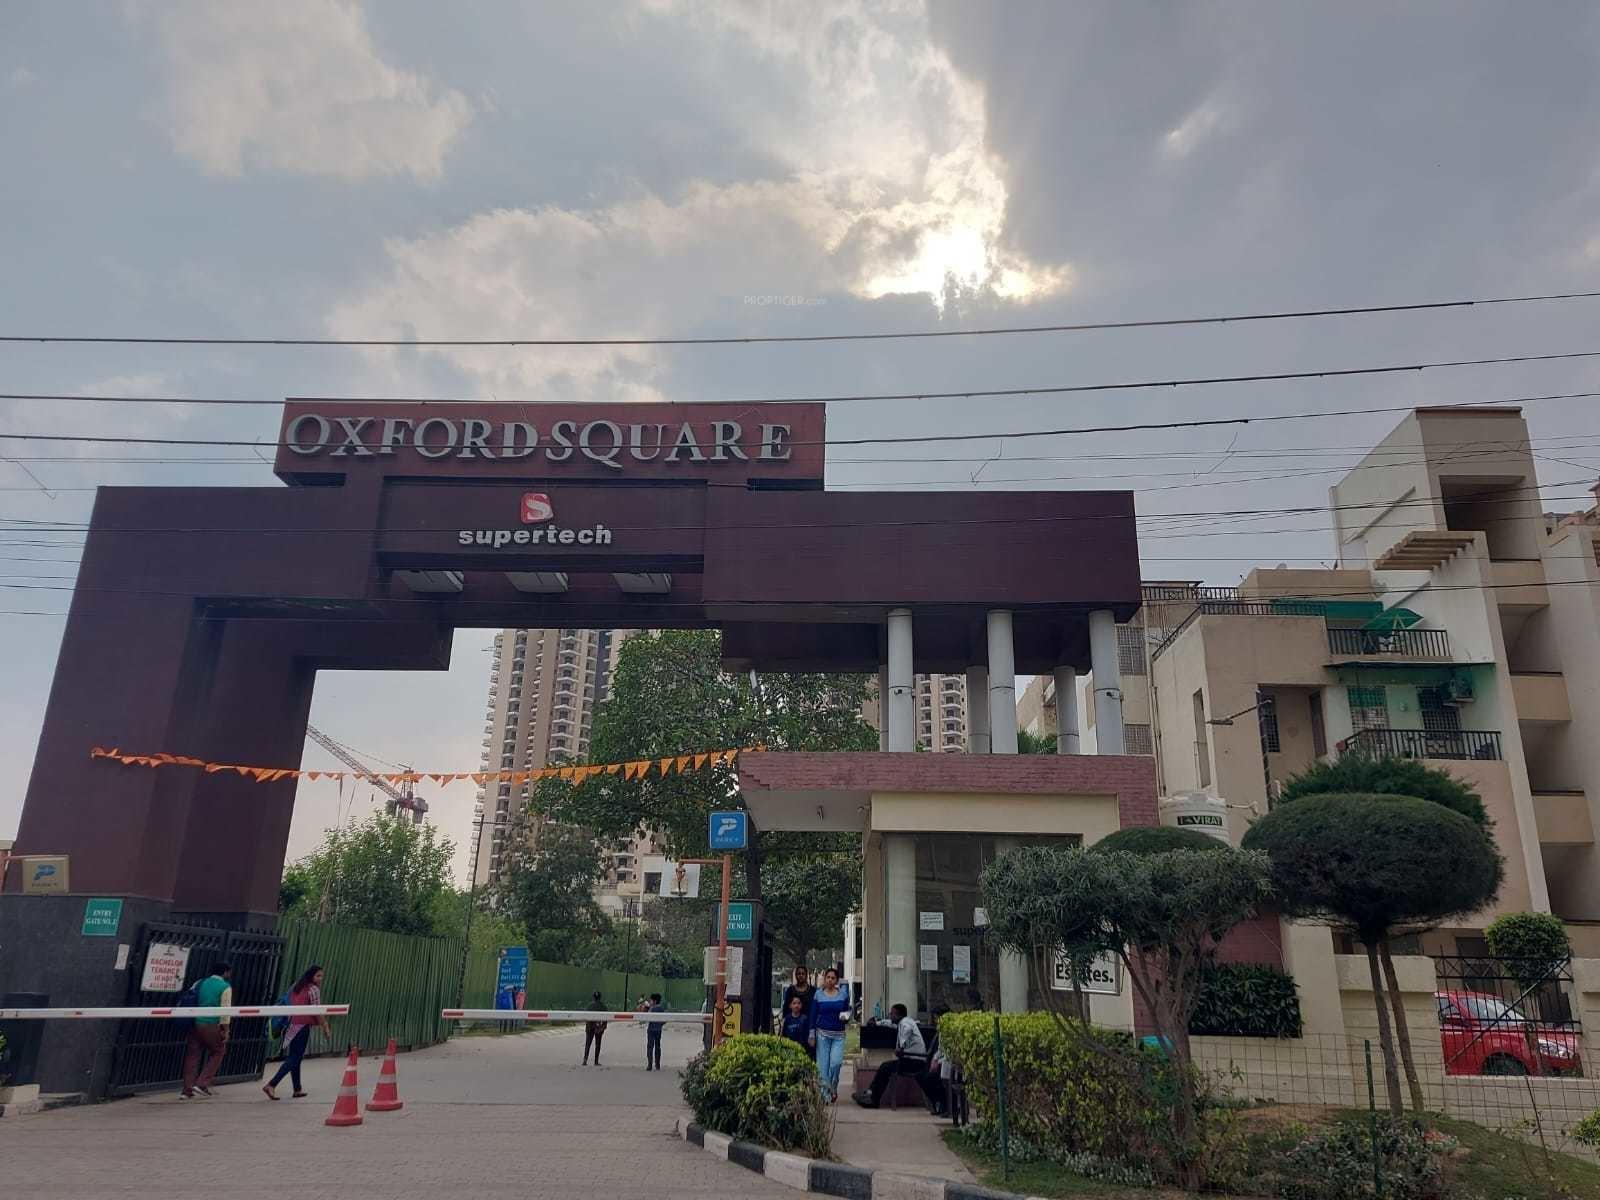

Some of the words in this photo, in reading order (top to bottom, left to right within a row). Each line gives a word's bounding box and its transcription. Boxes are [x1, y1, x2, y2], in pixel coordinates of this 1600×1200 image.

[286, 413, 538, 459] OXFORD
[545, 419, 793, 472] SQUARE
[458, 524, 612, 549] supertech
